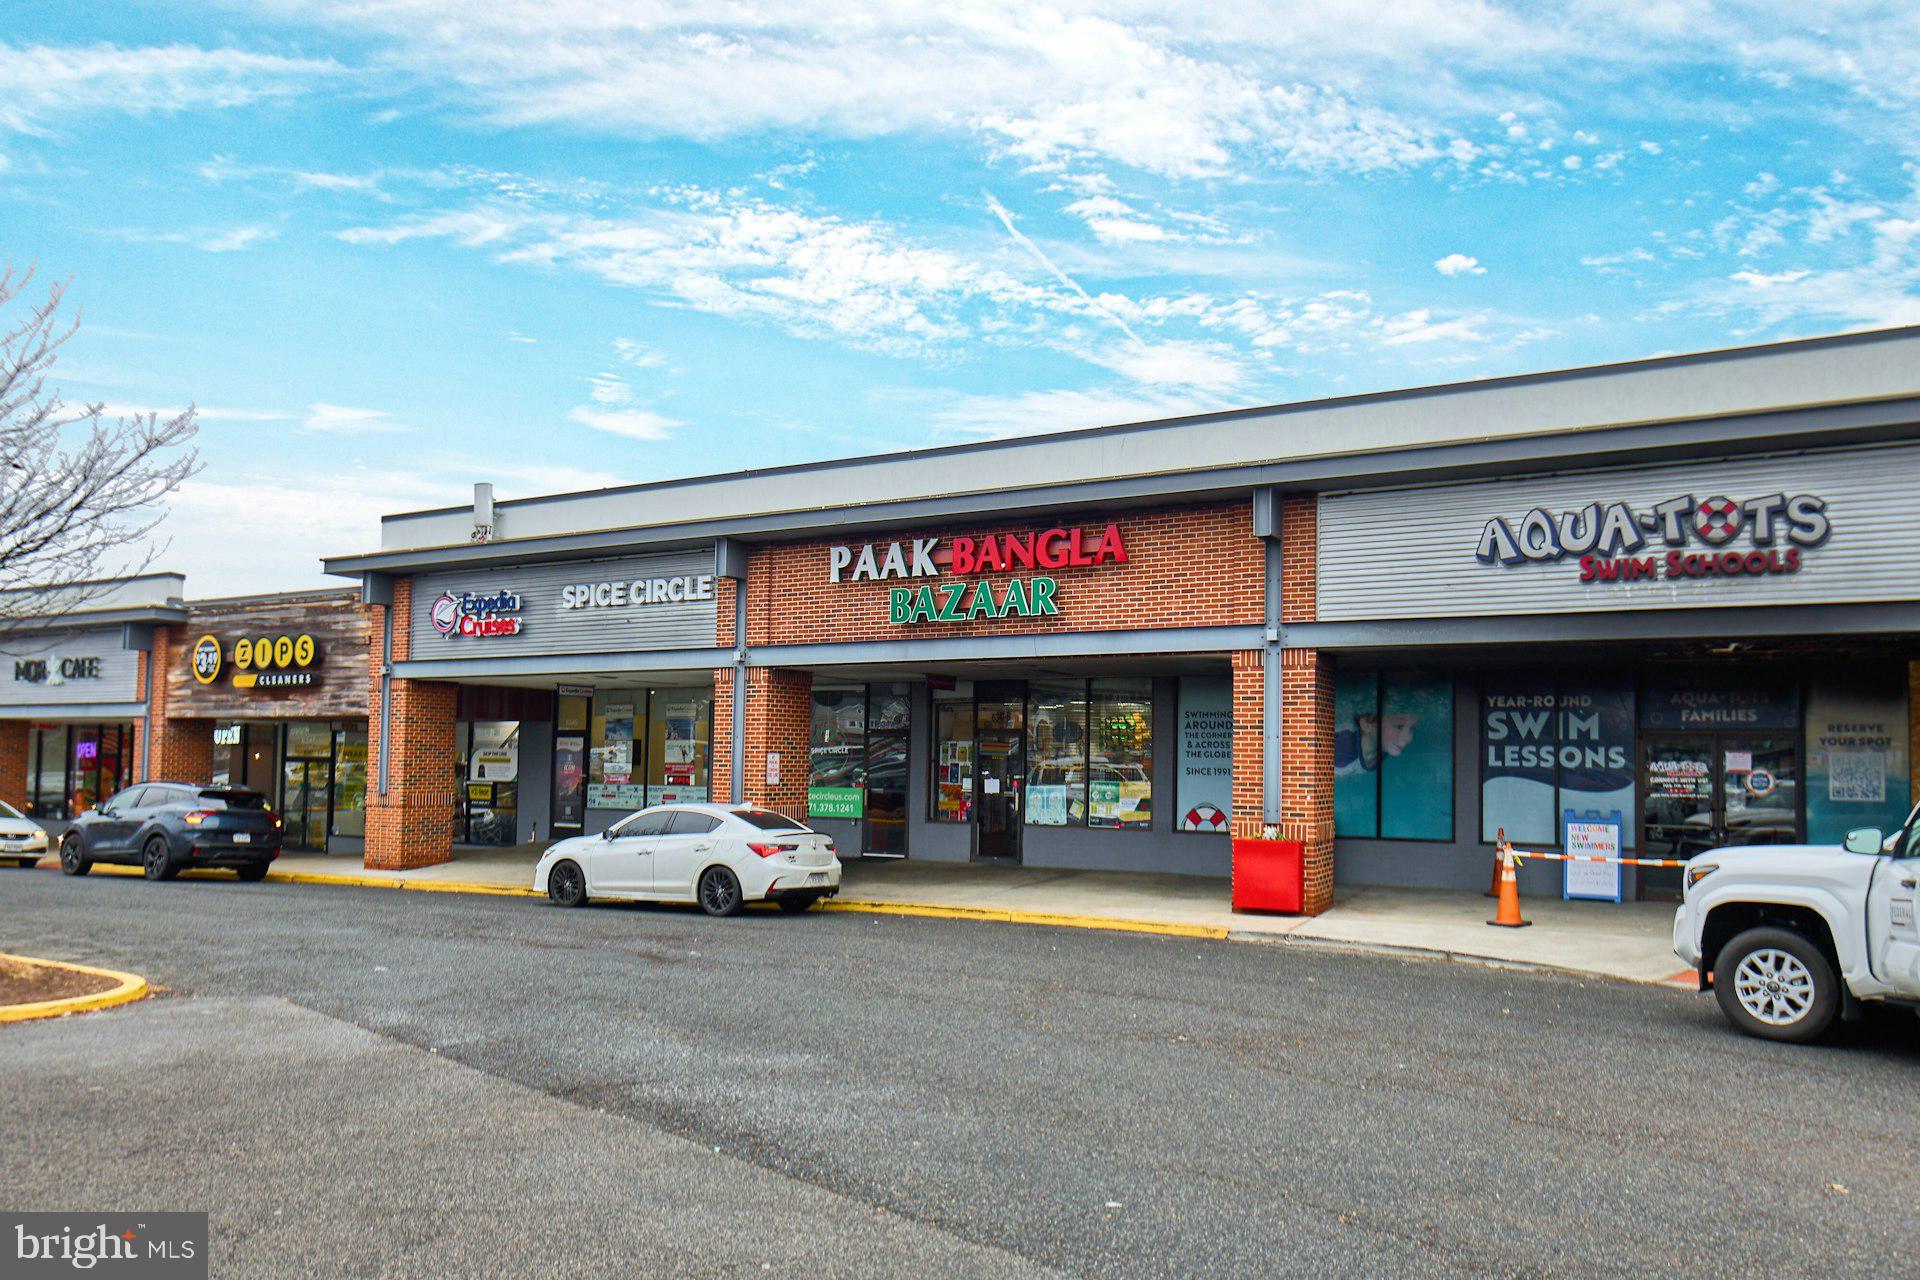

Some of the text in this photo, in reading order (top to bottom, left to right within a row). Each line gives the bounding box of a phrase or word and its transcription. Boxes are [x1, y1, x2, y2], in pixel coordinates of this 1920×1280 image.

[1475, 493, 1832, 566] AQUA-TOTS
[829, 524, 1128, 583] PAAK BANGLA
[1579, 549, 1801, 582] SWIM SCHOOLS
[562, 575, 715, 609] SPICE CIRCLE
[889, 577, 1059, 624] BAZAAR
[461, 590, 520, 619] Expedia
[460, 613, 521, 637] Cruises
[238, 638, 311, 665] ZIPS
[259, 673, 312, 686] CLEANERS
[1487, 695, 1591, 707] YEAR-ROUND
[1184, 711, 1233, 719] SWIMMING
[1681, 709, 1758, 721] FAMILIES
[1184, 721, 1233, 730] AROUND
[1487, 711, 1599, 740] SWIM
[1827, 724, 1883, 732] RESERVE
[1187, 741, 1230, 749] & ACROSS
[1819, 737, 1892, 746] YOUR SPOT
[1203, 751, 1232, 759] GLOBE
[1488, 745, 1626, 769] LESSONS
[1186, 767, 1231, 776] SINCE 1991
